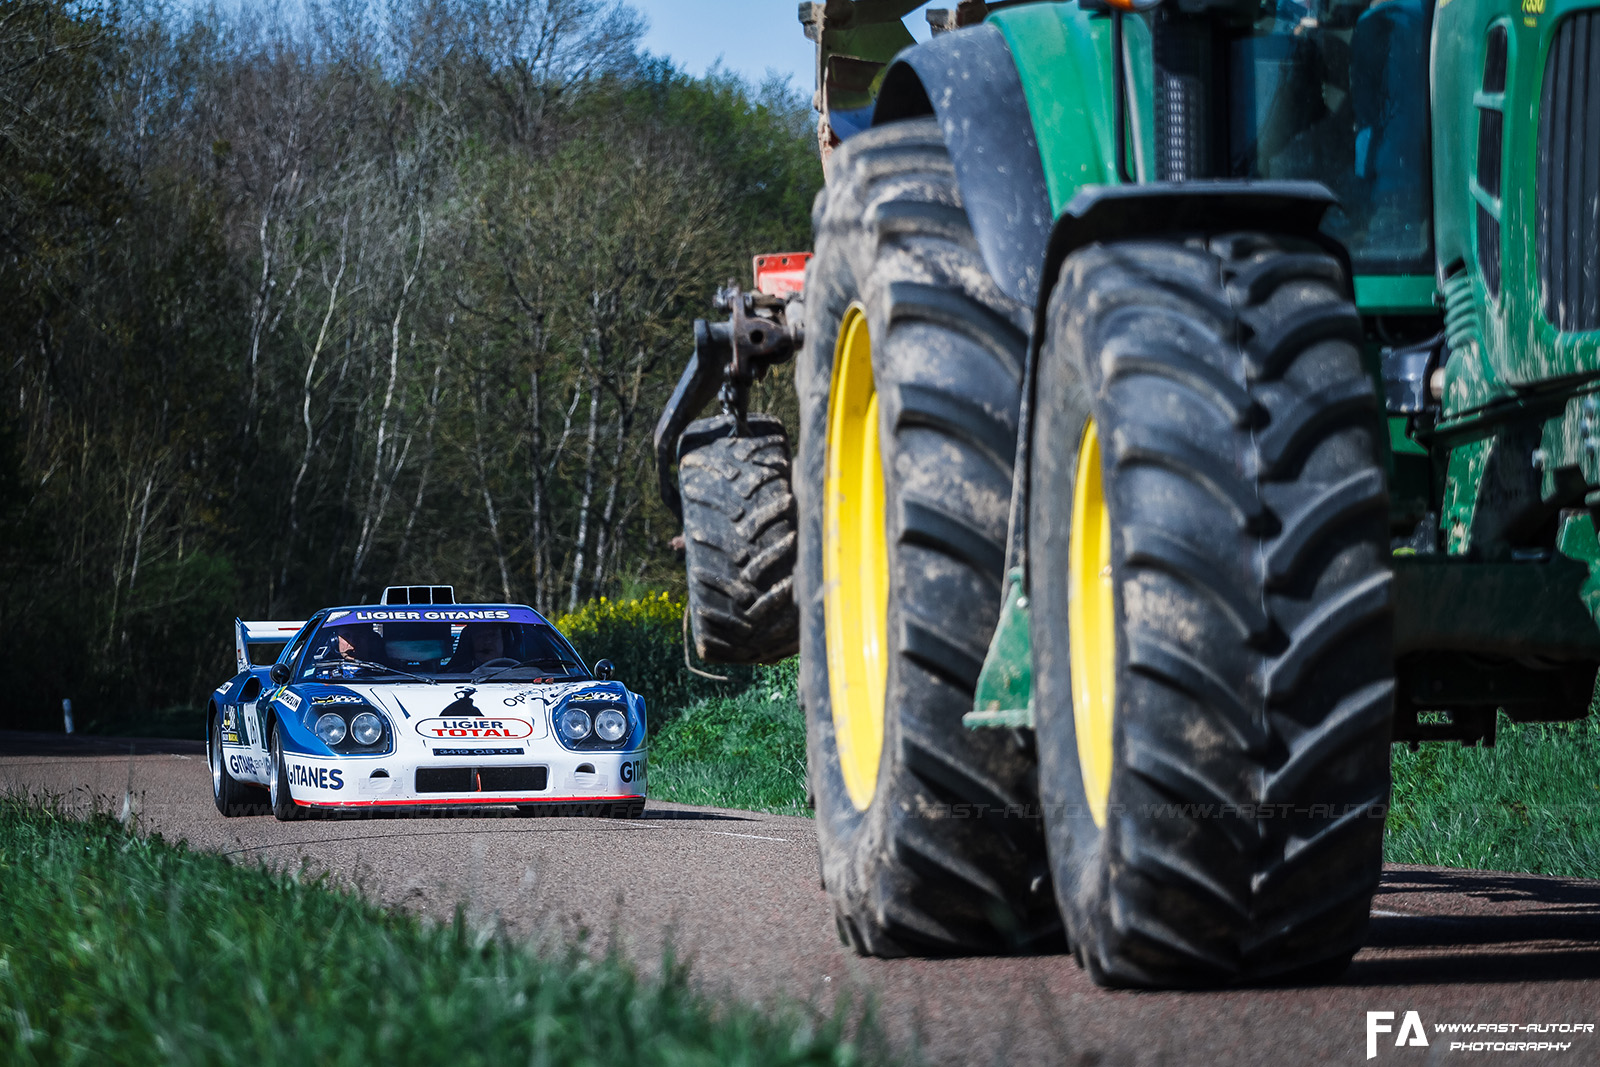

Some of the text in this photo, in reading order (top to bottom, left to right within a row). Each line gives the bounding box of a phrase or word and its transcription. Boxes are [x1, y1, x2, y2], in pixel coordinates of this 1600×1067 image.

[356, 610, 510, 620] LIGIER GITANES
[442, 720, 504, 729] LIGIER
[431, 728, 519, 737] TOTAL
